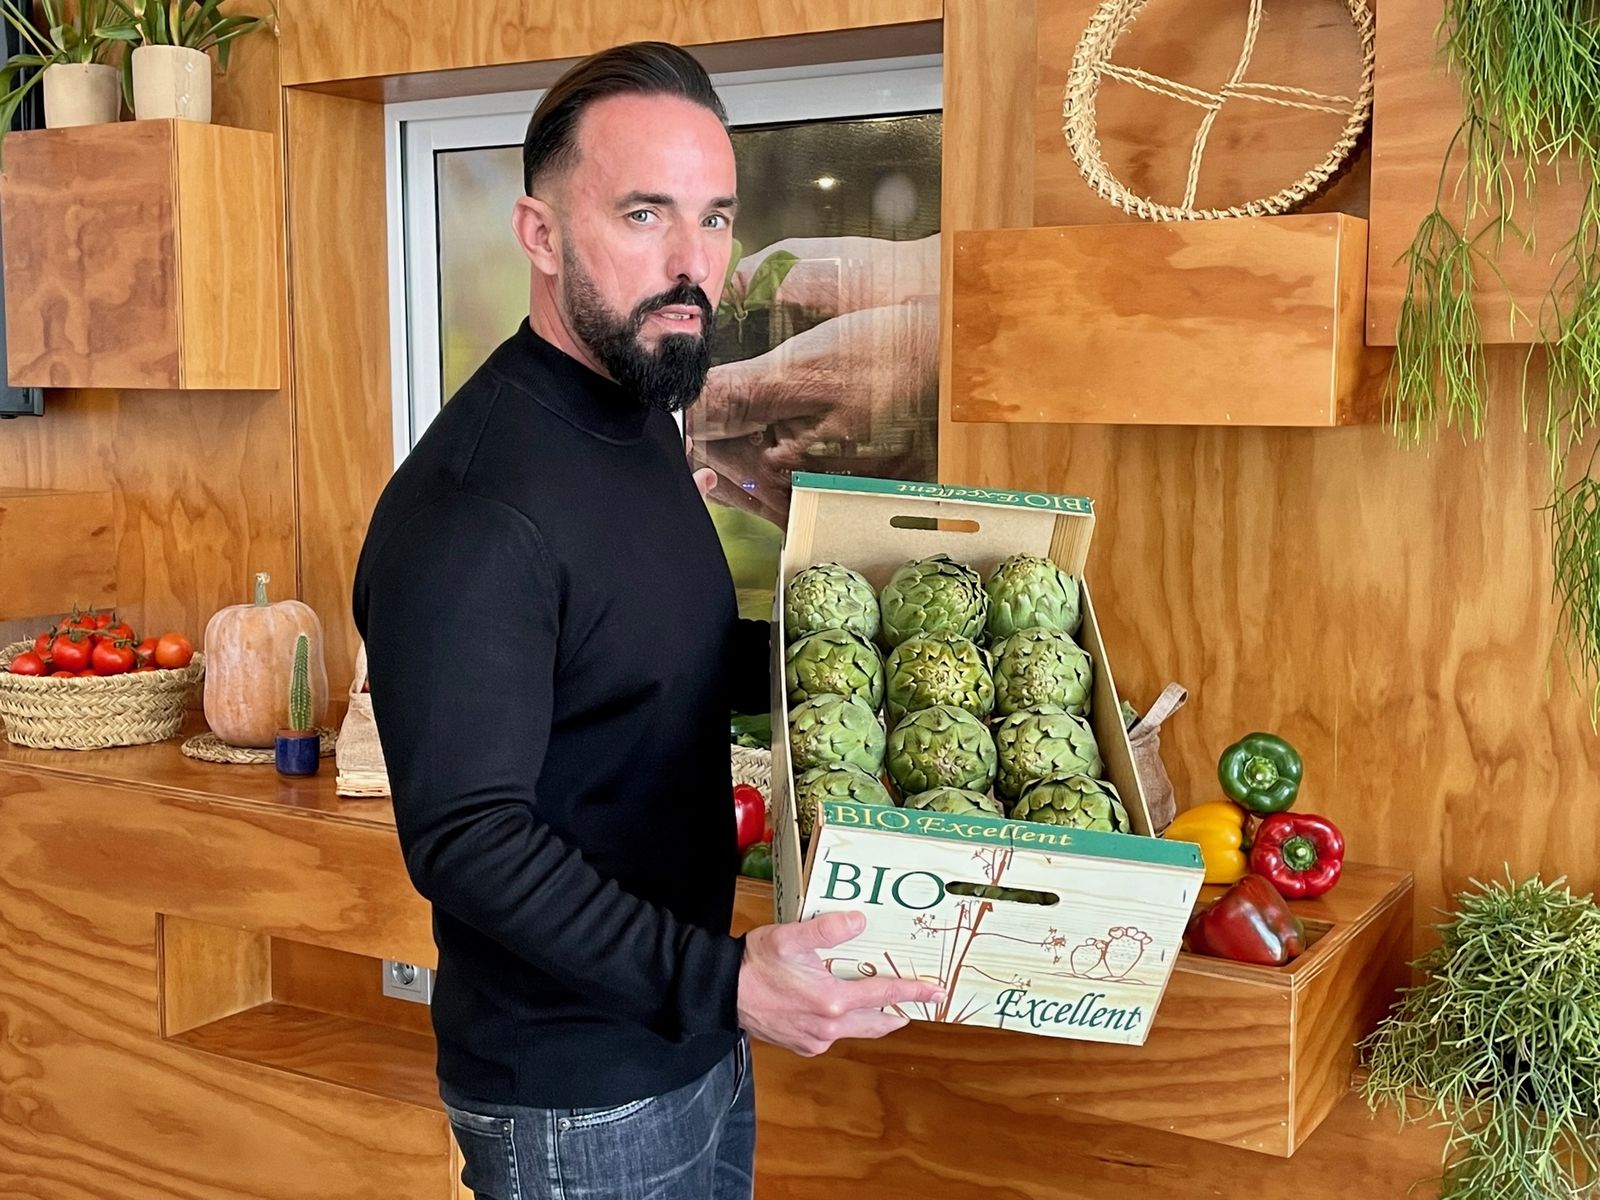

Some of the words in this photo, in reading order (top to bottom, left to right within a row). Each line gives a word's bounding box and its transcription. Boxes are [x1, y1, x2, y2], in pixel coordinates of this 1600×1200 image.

[897, 484, 1020, 504] Excellent
[1024, 494, 1085, 512] BIO
[835, 805, 910, 829] BIO
[916, 816, 1073, 846] Excellent
[819, 860, 946, 910] BIO
[994, 988, 1142, 1031] Excellent
